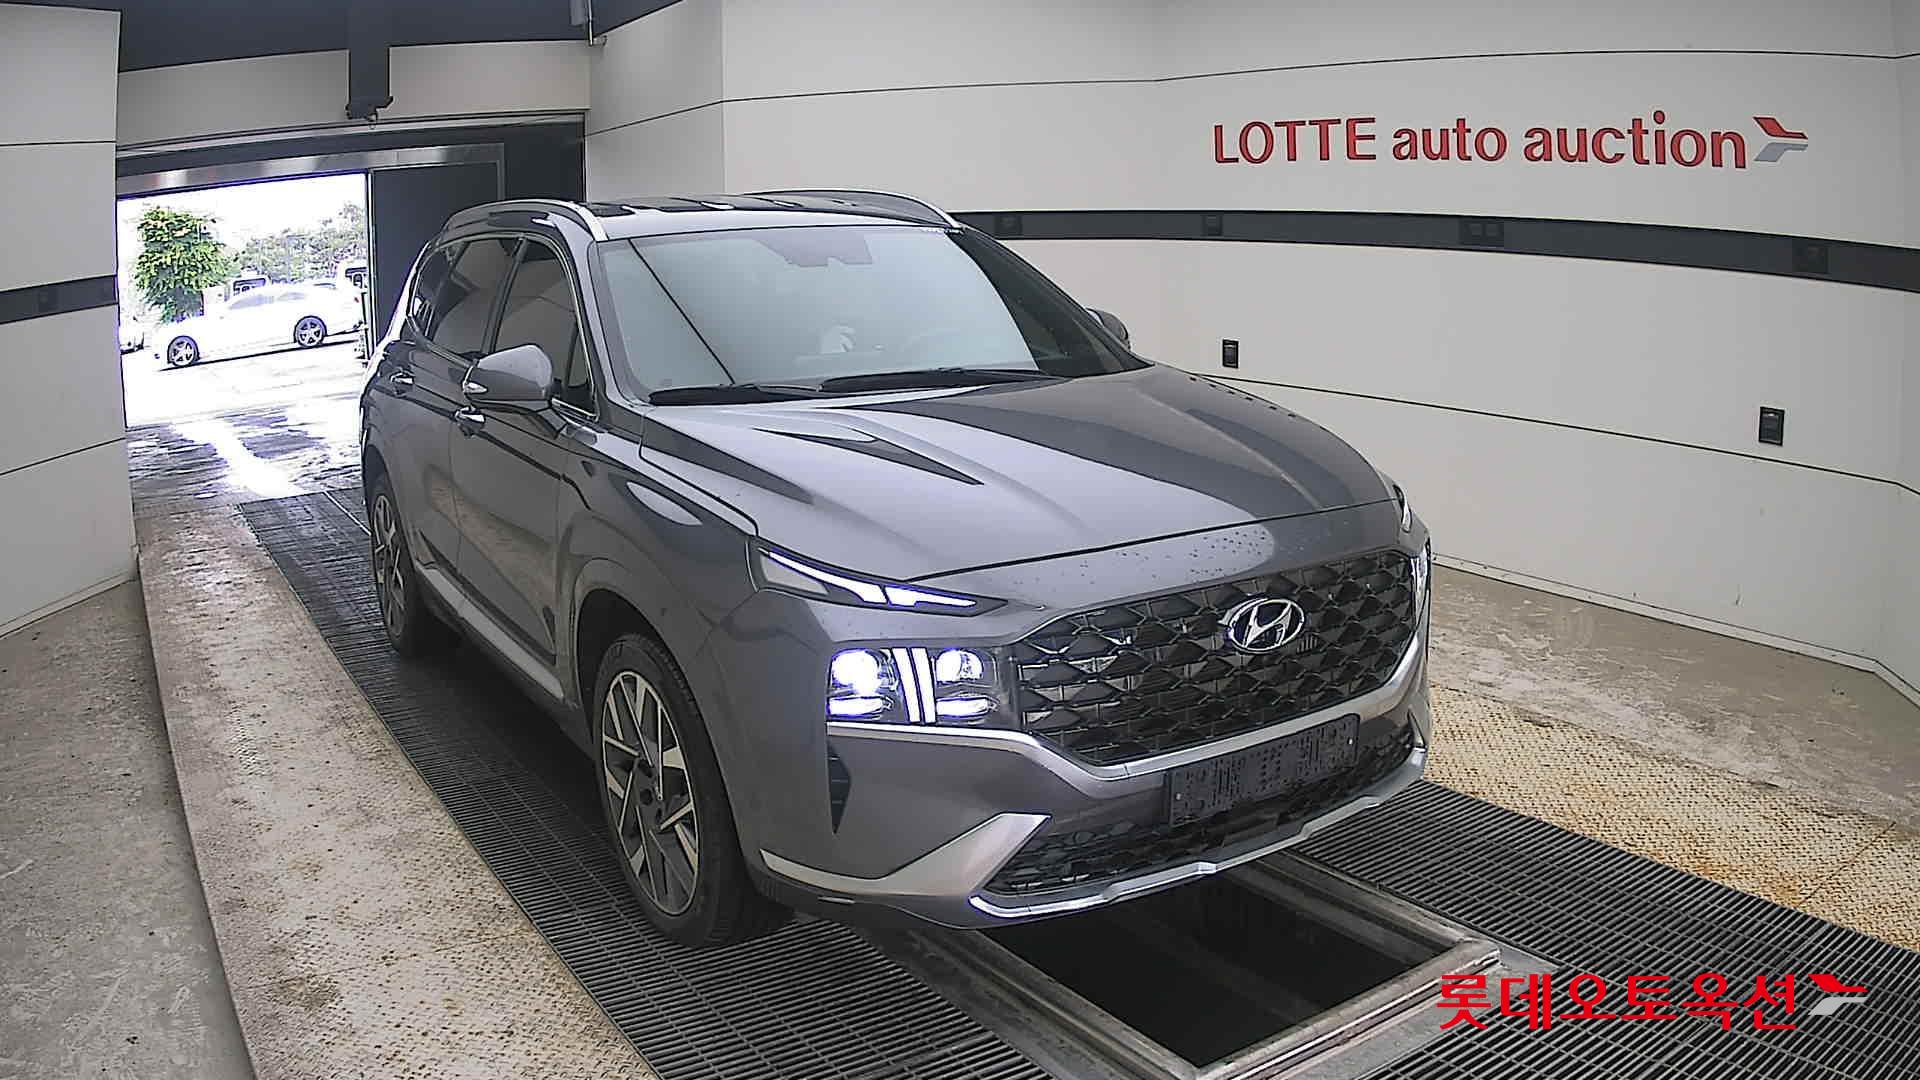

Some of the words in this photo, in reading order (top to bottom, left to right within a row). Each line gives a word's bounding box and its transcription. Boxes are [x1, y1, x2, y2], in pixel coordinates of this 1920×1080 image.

[1213, 117, 1377, 164] LOTTE
[1392, 118, 1508, 162] auto
[1523, 110, 1747, 168] auction
